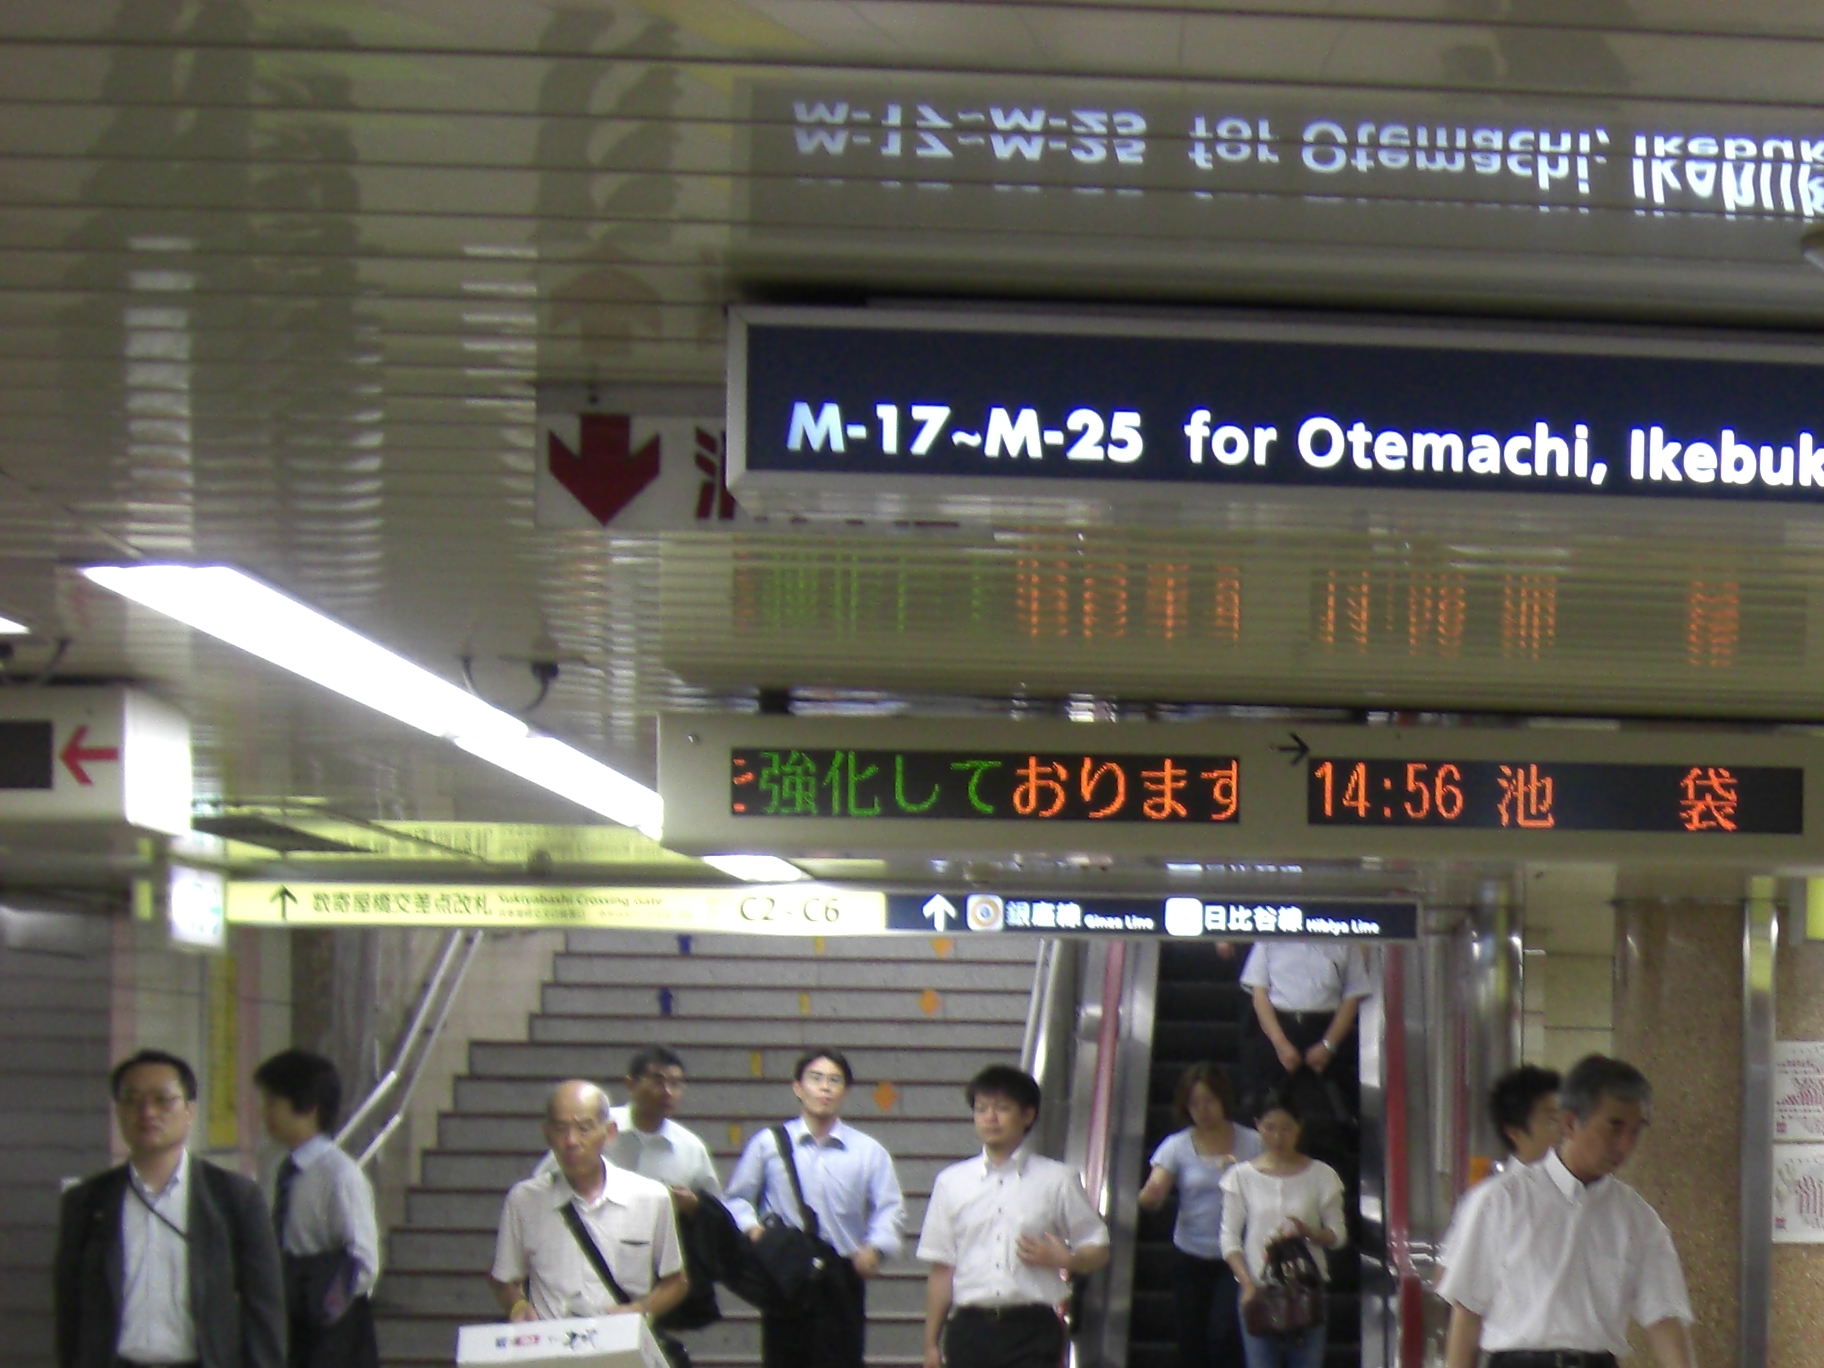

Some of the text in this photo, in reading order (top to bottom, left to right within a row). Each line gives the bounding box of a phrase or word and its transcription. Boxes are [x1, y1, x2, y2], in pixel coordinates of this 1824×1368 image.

[1184, 411, 1269, 467] for
[1297, 418, 1607, 486] Otemachi,
[1315, 761, 1464, 819] 14:56
[1204, 904, 1303, 933] 日比谷線
